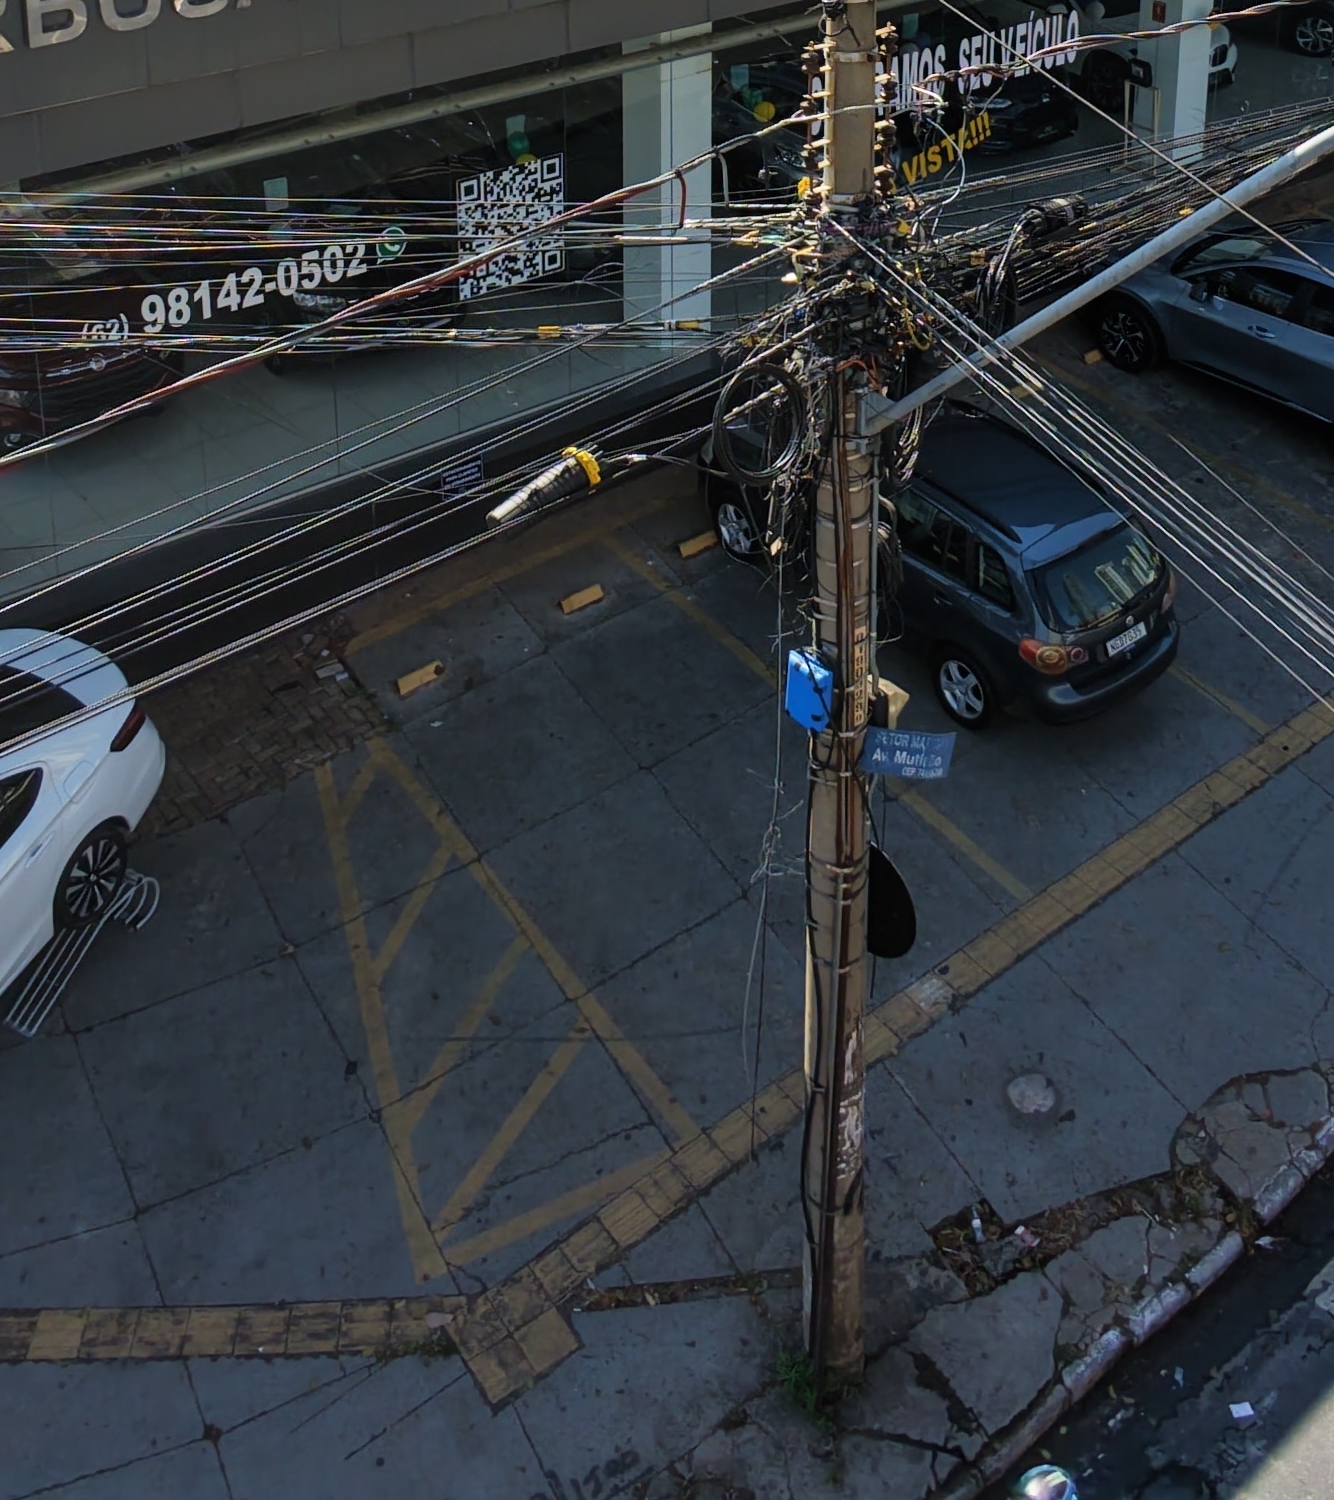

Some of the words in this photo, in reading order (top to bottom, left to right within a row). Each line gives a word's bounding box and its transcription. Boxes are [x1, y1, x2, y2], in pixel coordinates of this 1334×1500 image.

[957, 30, 995, 95] SEU
[1000, 9, 1080, 78] VEÍCULO
[140, 238, 368, 334] 98142-0502
